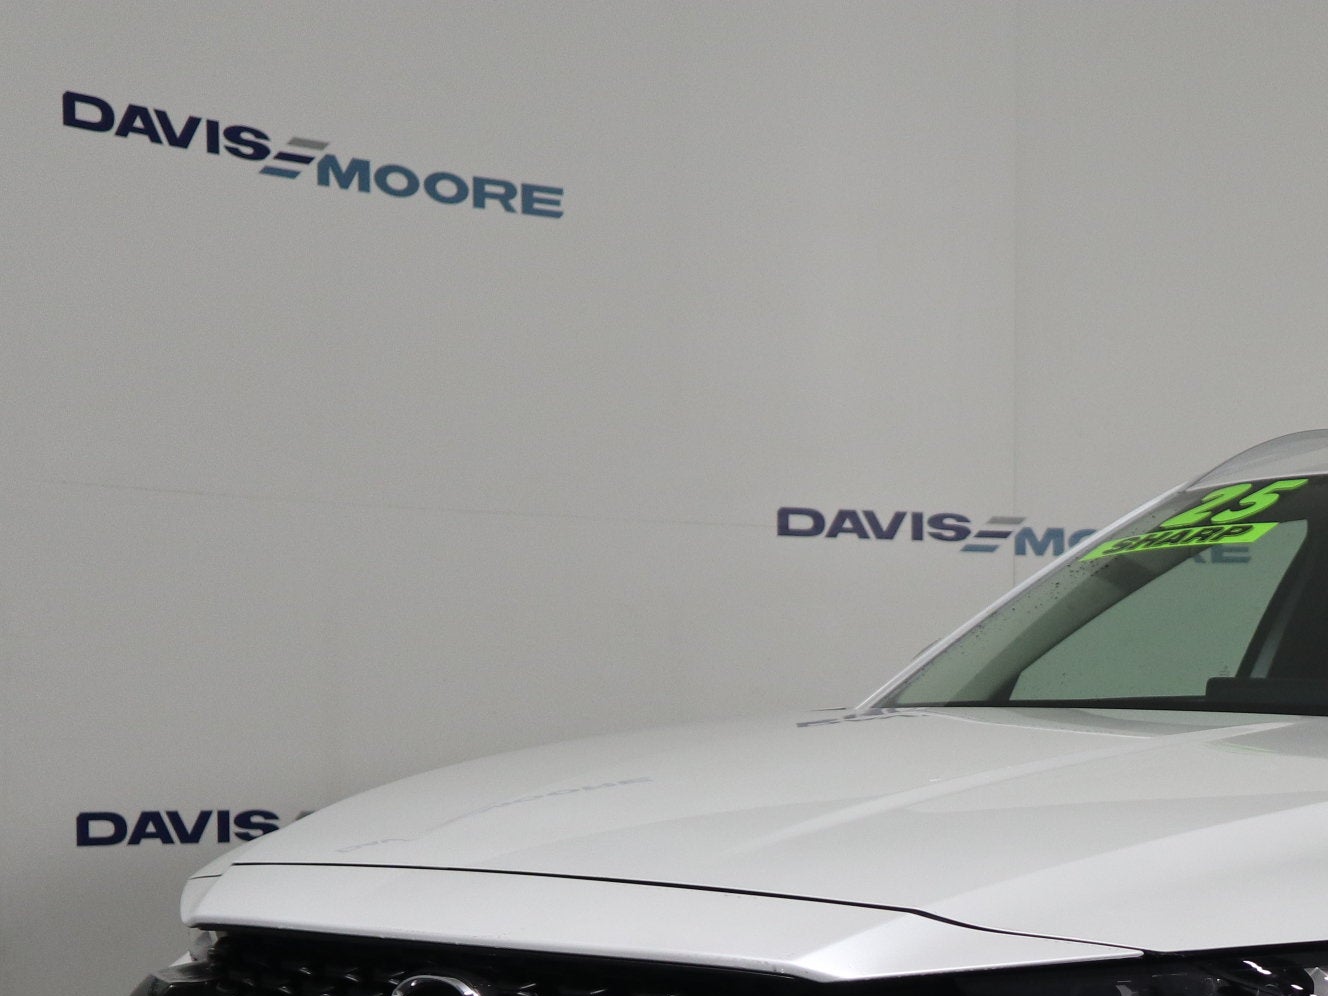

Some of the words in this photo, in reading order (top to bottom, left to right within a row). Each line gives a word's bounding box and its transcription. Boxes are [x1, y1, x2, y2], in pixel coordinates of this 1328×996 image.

[62, 90, 271, 162] DAVIS
[316, 153, 564, 219] MOORE
[1160, 478, 1309, 529] 25
[776, 506, 973, 543] DAVIS
[1101, 524, 1254, 556] SHARP
[76, 809, 280, 847] DAVIS
